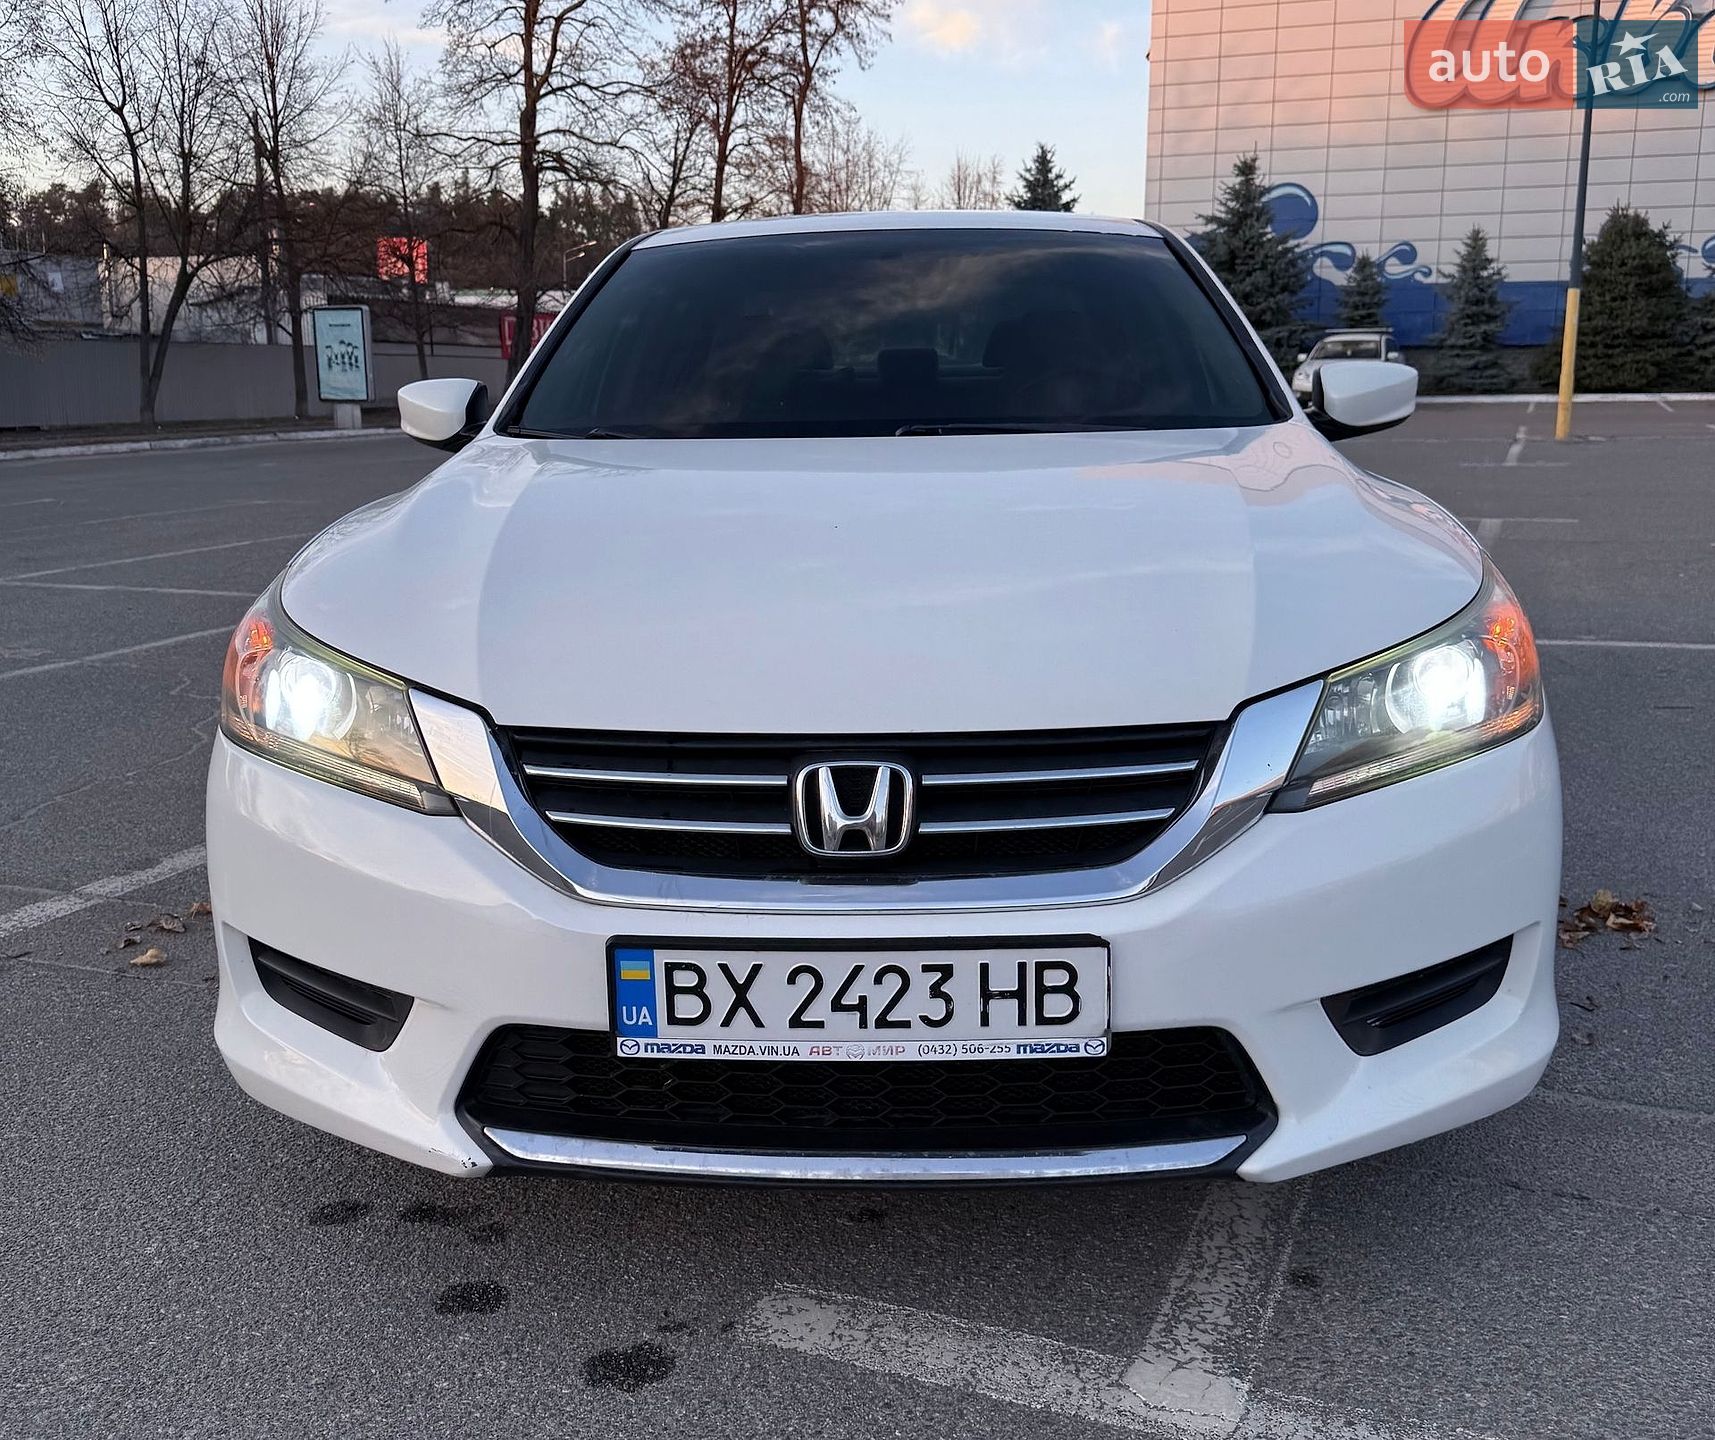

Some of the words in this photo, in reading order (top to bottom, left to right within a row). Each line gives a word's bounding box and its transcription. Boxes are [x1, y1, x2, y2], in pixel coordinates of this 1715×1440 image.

[663, 960, 766, 1029] BX
[785, 962, 955, 1030] 2423
[978, 959, 1083, 1027] HB
[621, 1005, 654, 1027] UA
[712, 1044, 800, 1057] MAZDA.VIN.UA
[917, 1043, 958, 1058] (0432)
[961, 1042, 1011, 1055] 506-255
